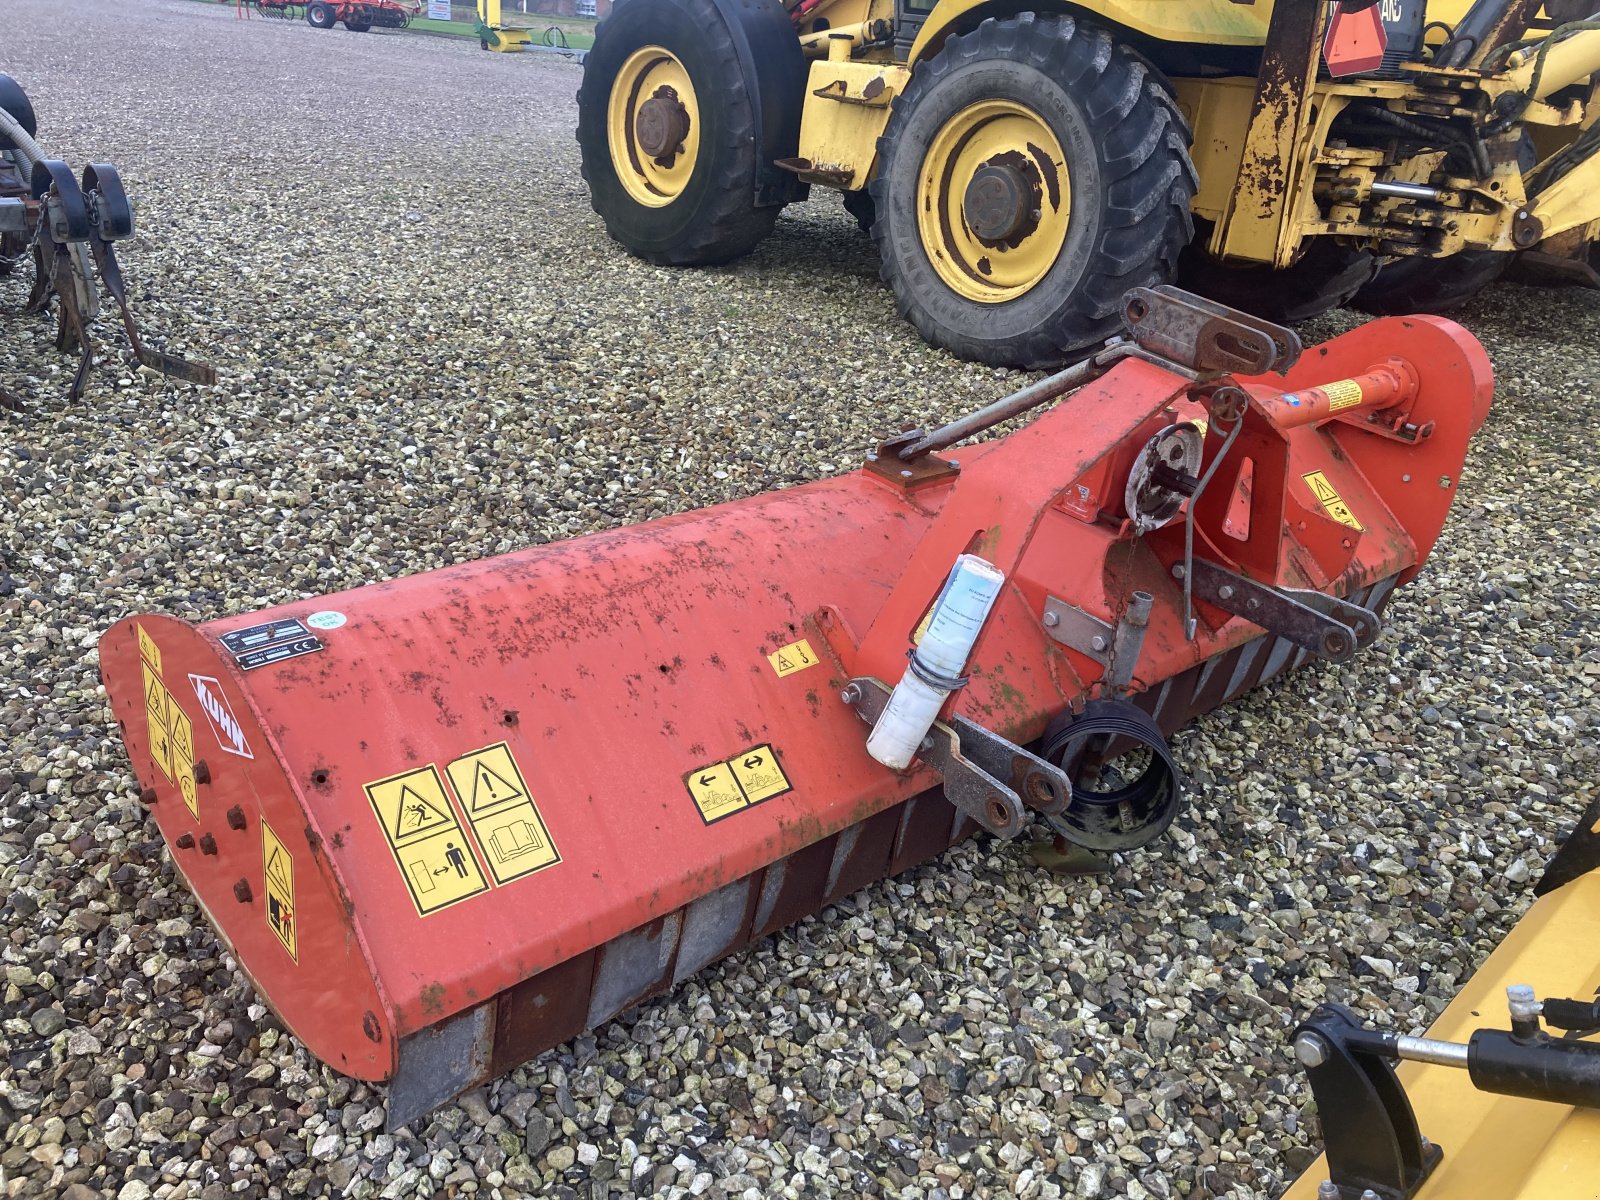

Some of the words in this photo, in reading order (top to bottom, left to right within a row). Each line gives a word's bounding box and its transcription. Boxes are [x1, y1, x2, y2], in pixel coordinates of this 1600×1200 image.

[309, 613, 338, 623] TEST
[321, 619, 339, 627] OK
[196, 677, 245, 754] KUHN
